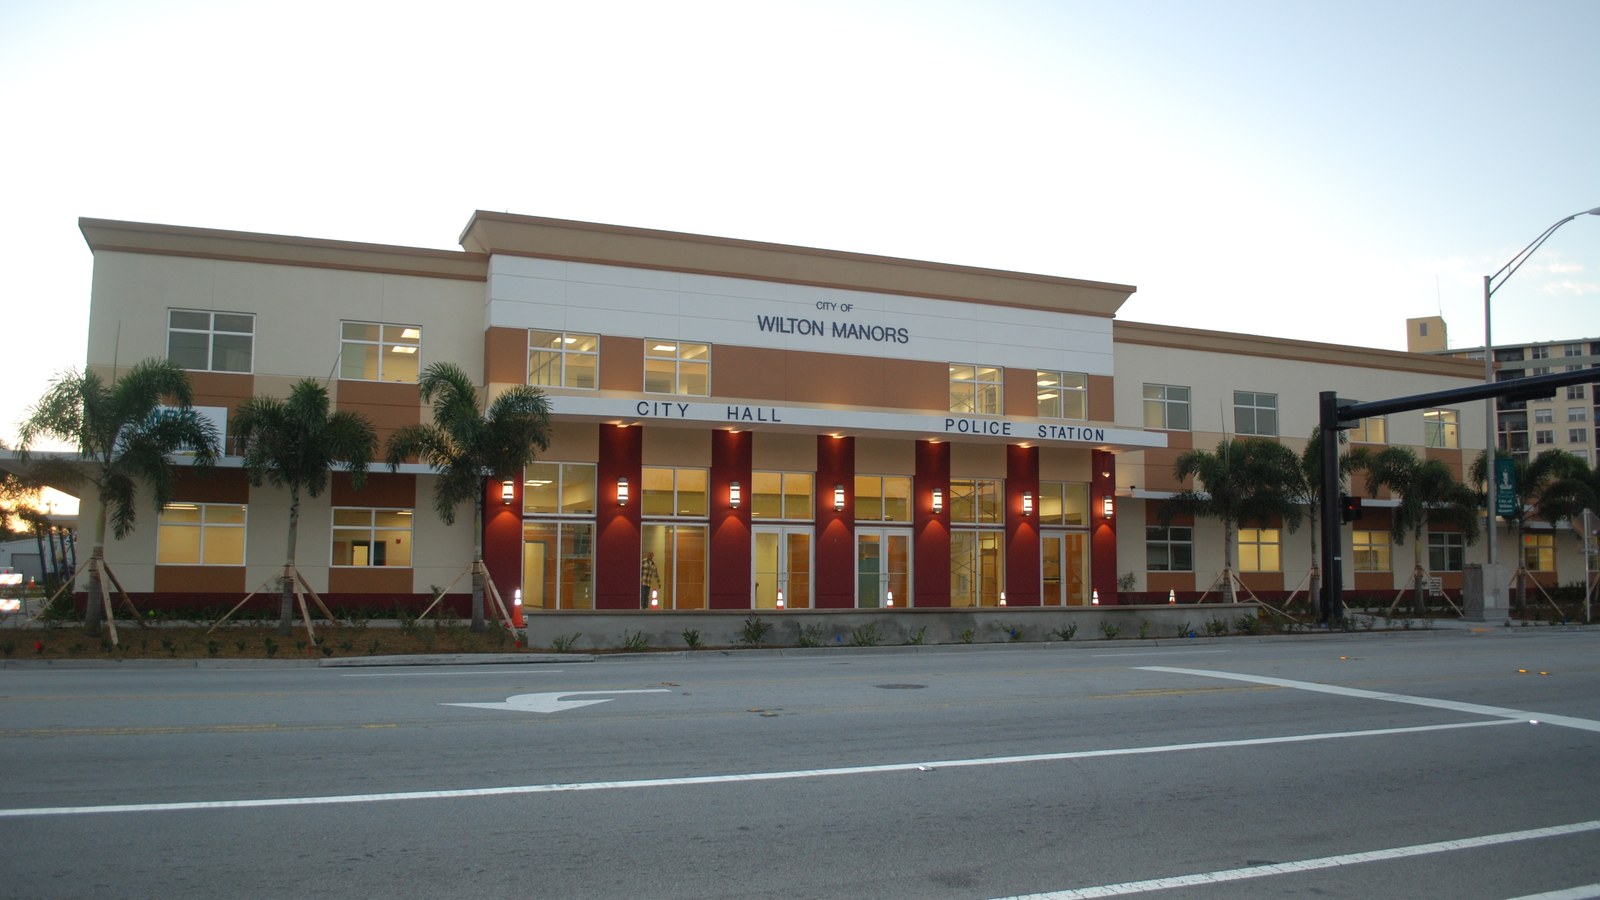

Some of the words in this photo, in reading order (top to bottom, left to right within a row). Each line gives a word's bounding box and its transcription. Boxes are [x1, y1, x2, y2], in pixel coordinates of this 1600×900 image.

[816, 301, 837, 311] CITY
[840, 303, 853, 312] OF
[757, 315, 824, 337] WILTON
[832, 321, 909, 344] MANORS
[636, 401, 689, 418] CITY
[727, 406, 781, 422] HALL
[945, 418, 1012, 435] POLICE
[1038, 425, 1104, 441] STATION
